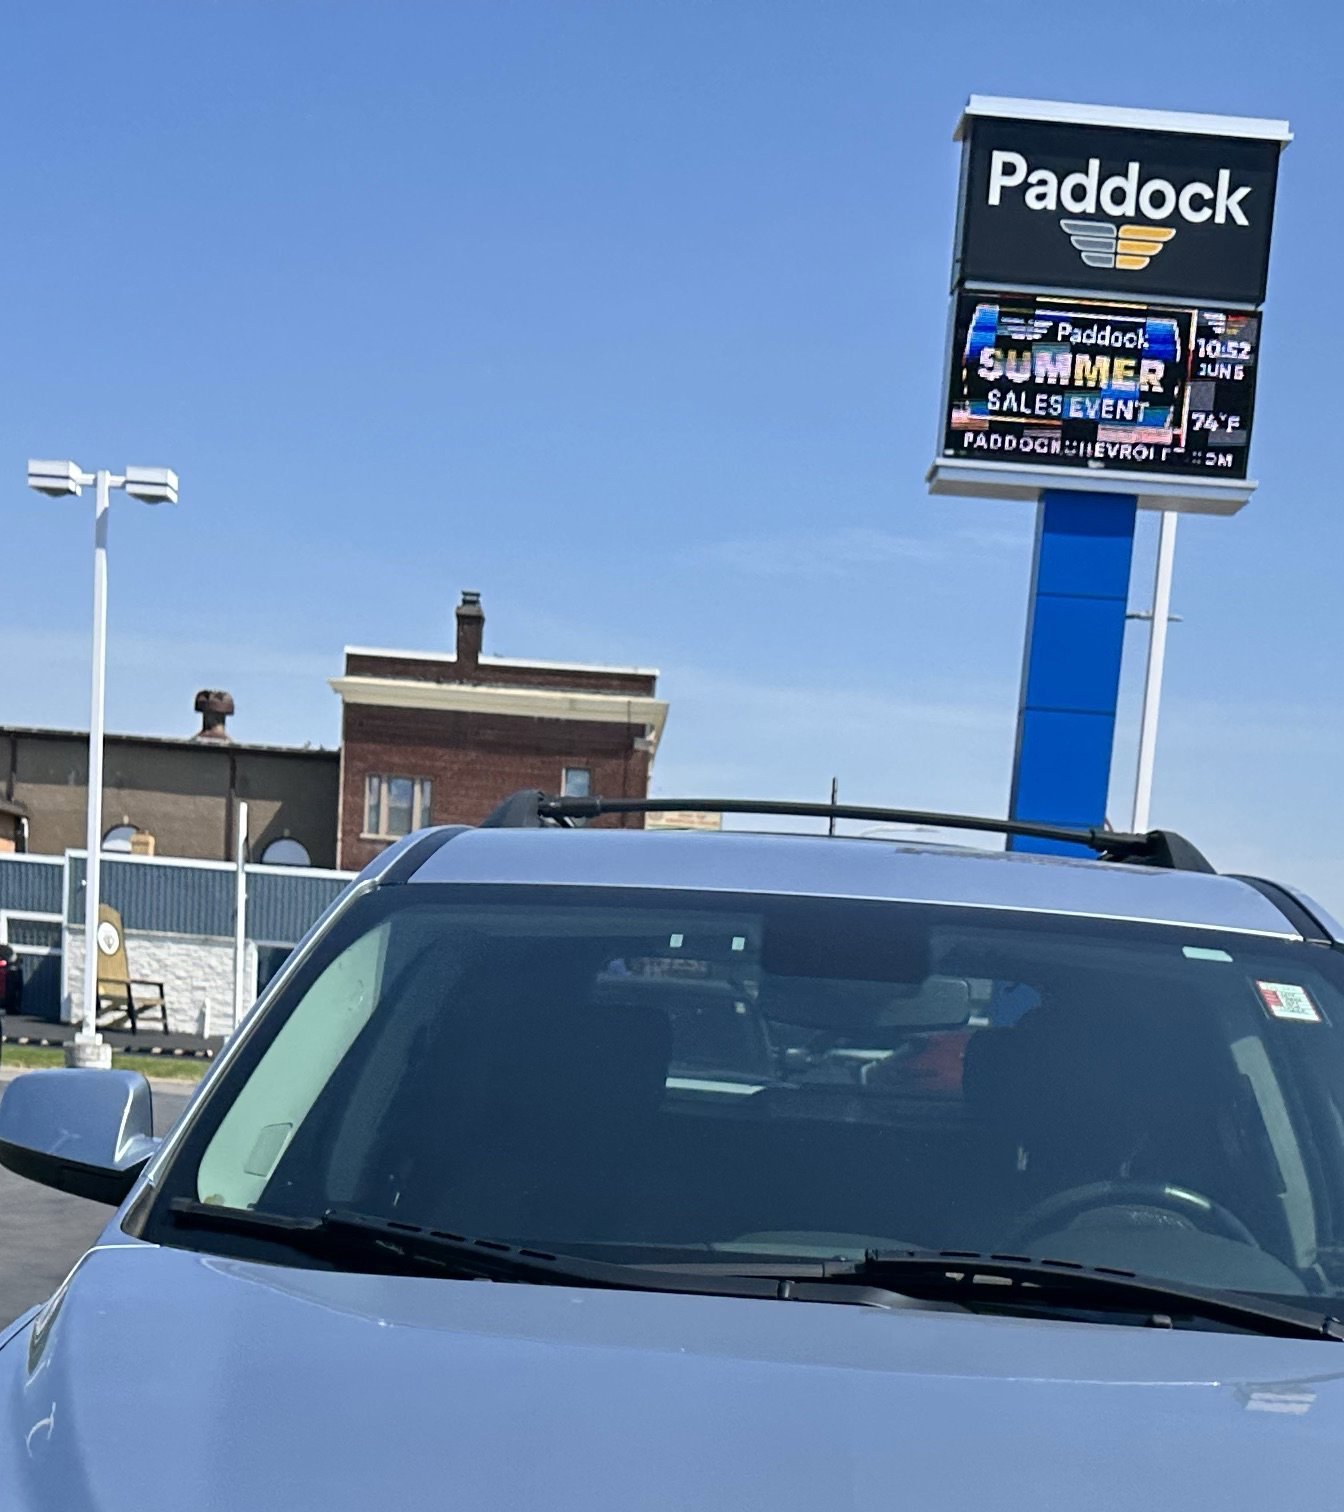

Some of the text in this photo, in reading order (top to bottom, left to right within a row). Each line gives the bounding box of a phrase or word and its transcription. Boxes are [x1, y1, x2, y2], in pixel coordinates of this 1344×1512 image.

[987, 149, 1253, 226] Paddock
[1057, 321, 1151, 349] Paddock
[977, 346, 1166, 393] SUMMER
[1199, 363, 1232, 380] JUN
[987, 388, 1151, 422] SALES EVENT
